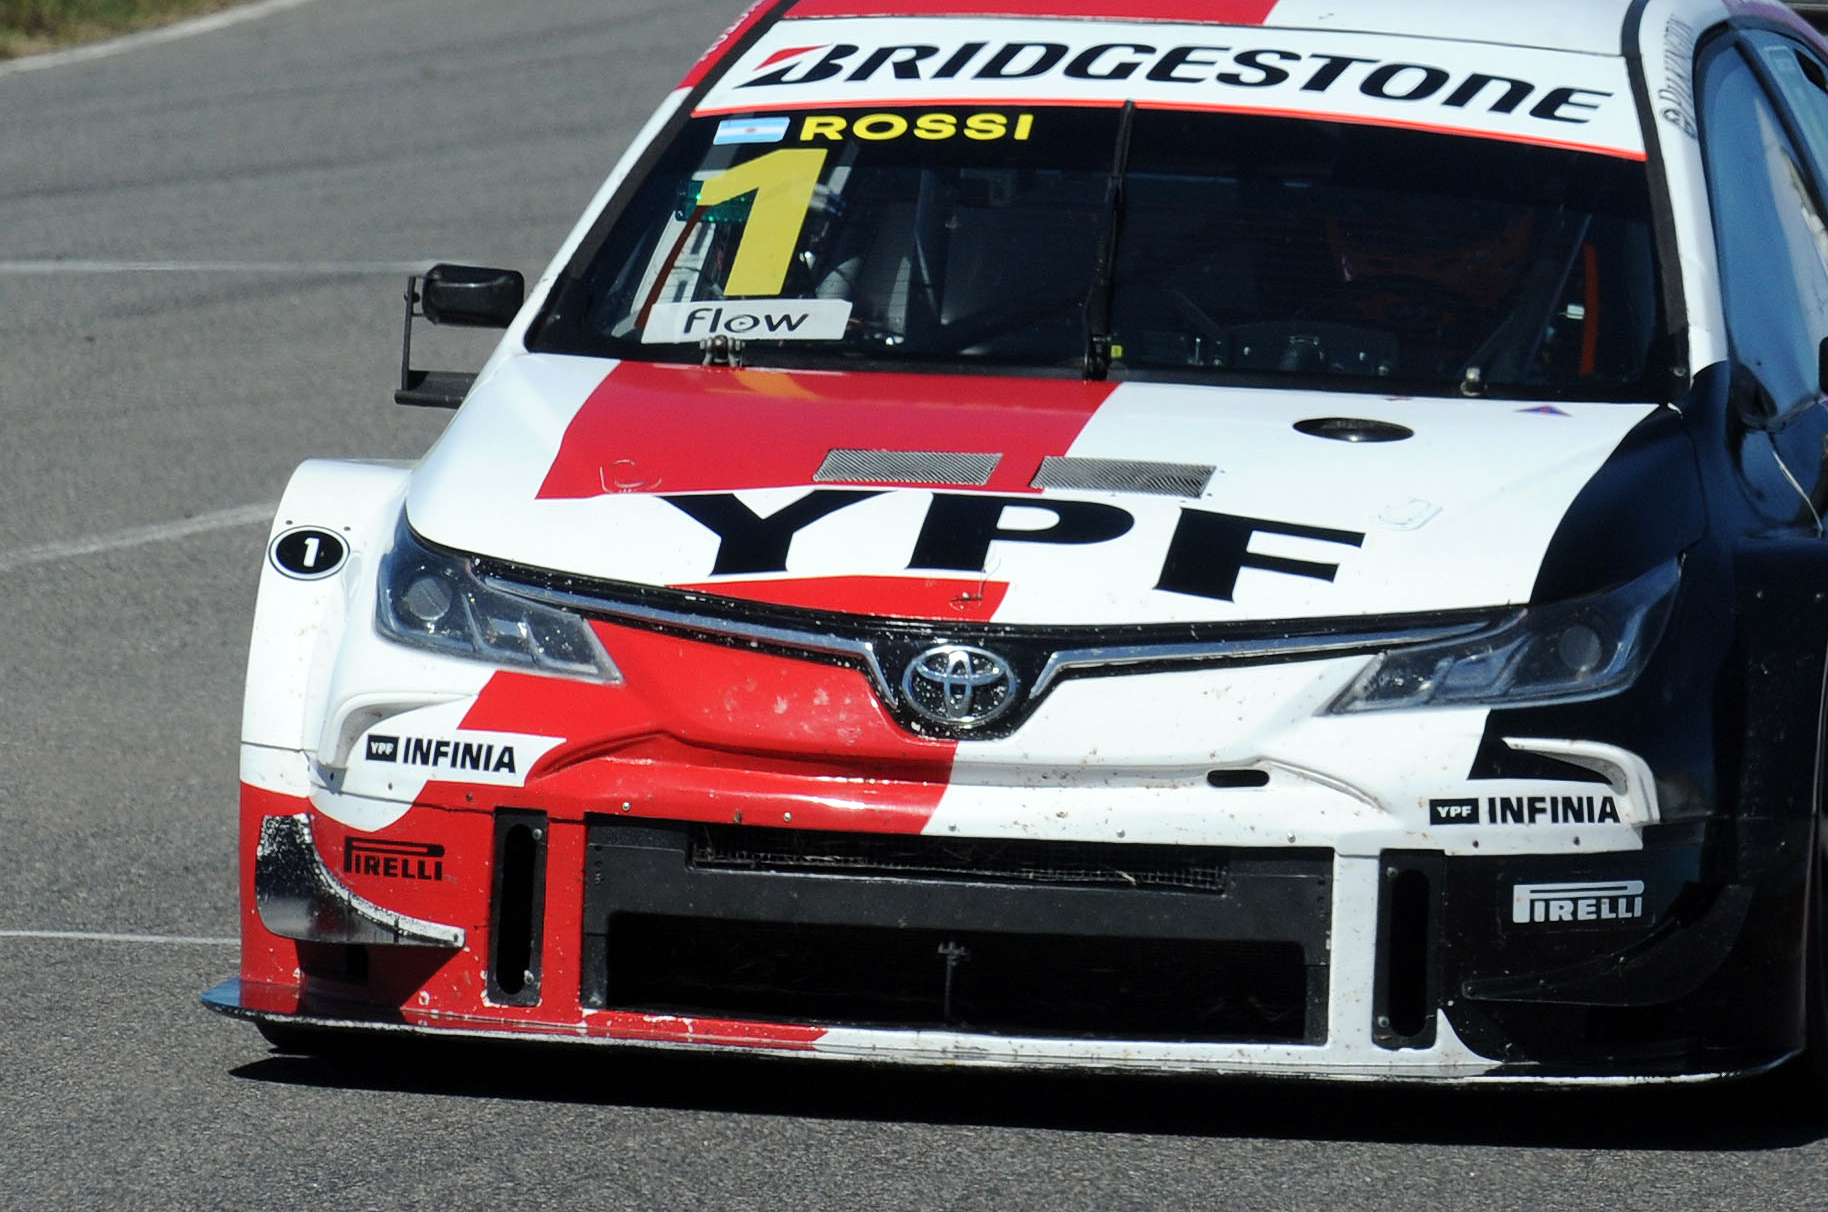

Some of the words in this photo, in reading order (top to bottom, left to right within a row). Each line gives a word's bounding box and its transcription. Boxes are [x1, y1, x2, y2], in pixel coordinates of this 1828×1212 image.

[733, 40, 1615, 124] BRIDGESTONE
[800, 113, 1034, 141] ROSSI
[696, 148, 828, 296] 1
[303, 536, 320, 568] 1
[651, 489, 1365, 604] YPF
[370, 741, 394, 756] YPF
[402, 737, 516, 774] INFINIA
[1437, 805, 1473, 819] YPF
[1487, 796, 1622, 825] INFINIA
[343, 835, 445, 882] PIRELLI
[1512, 879, 1645, 924] PIRELLI
